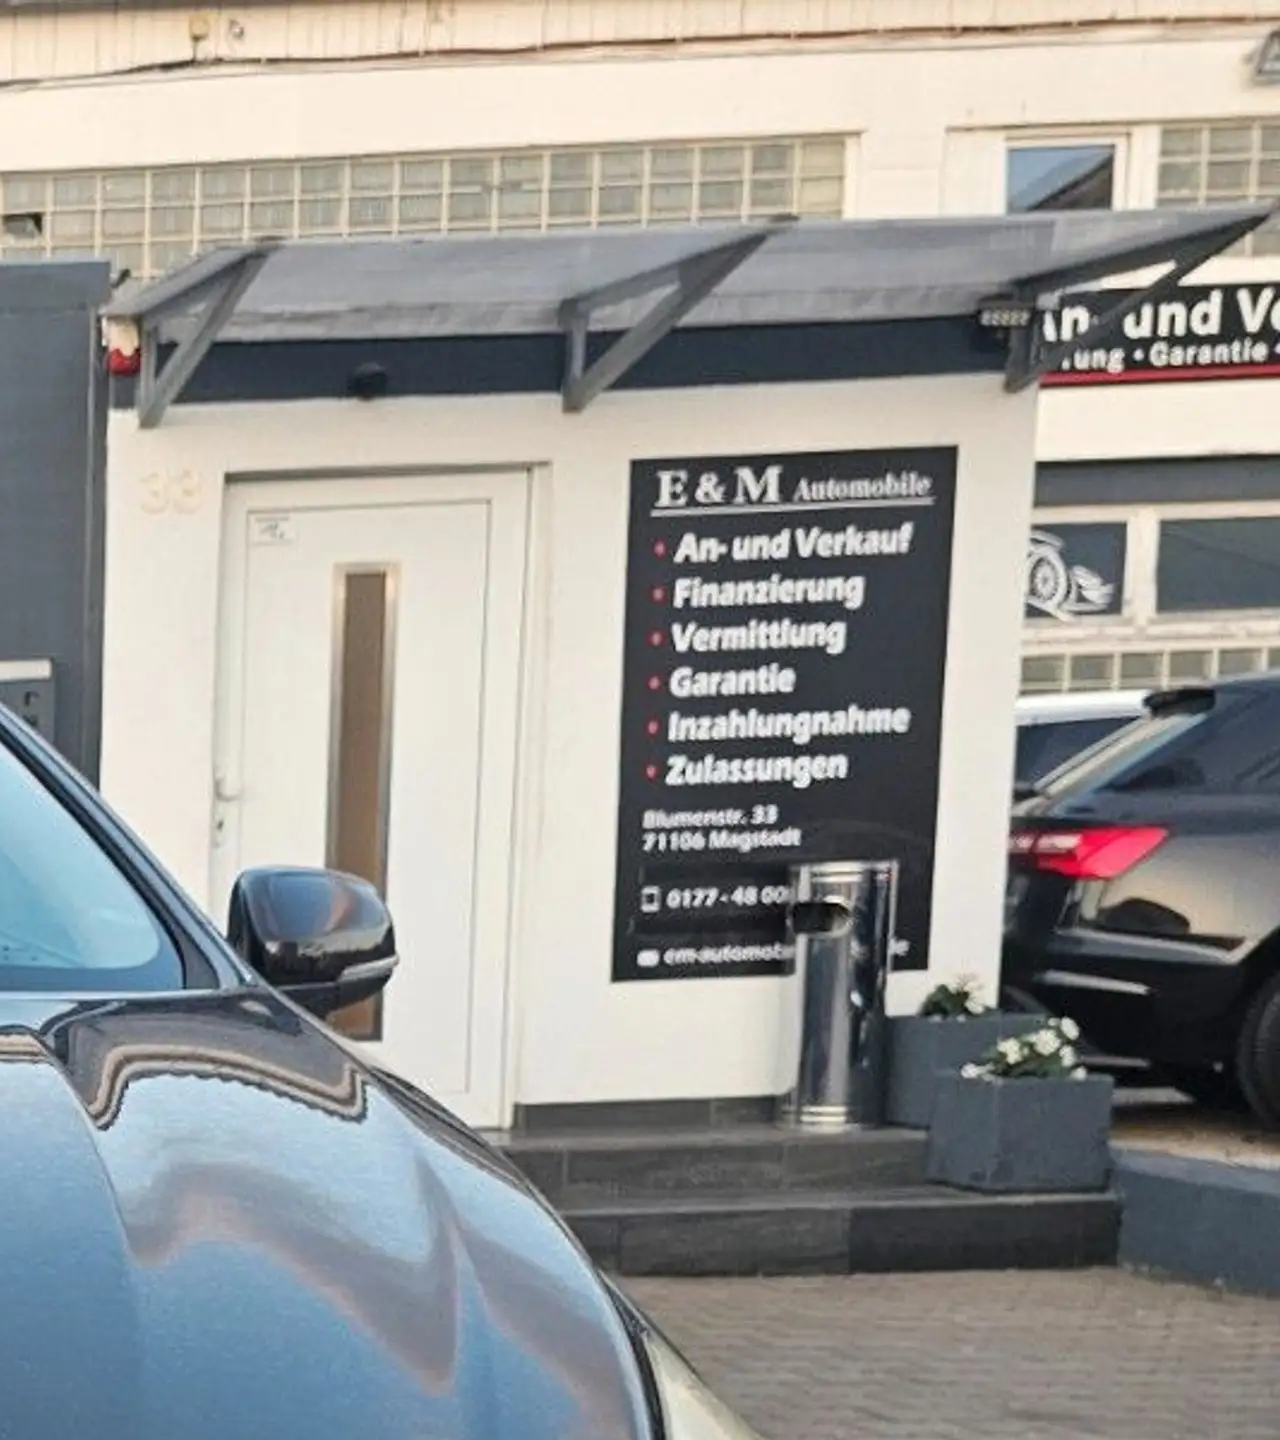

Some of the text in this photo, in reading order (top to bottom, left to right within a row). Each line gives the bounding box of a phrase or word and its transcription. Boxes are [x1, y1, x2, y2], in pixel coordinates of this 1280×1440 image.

[1123, 289, 1223, 339] und
[1149, 337, 1269, 367] Garantie
[793, 470, 933, 501] Automobile
[673, 521, 914, 563] An- und Verkauf
[672, 572, 866, 610] Finanzierung
[671, 617, 847, 655] Vermittlung
[669, 662, 796, 697] Garantie
[668, 703, 912, 745] Inzahlungnahme
[665, 753, 849, 789] Zulassungen
[642, 804, 778, 829] Blumenstr. 33
[642, 826, 802, 853] 71106 Magstadt
